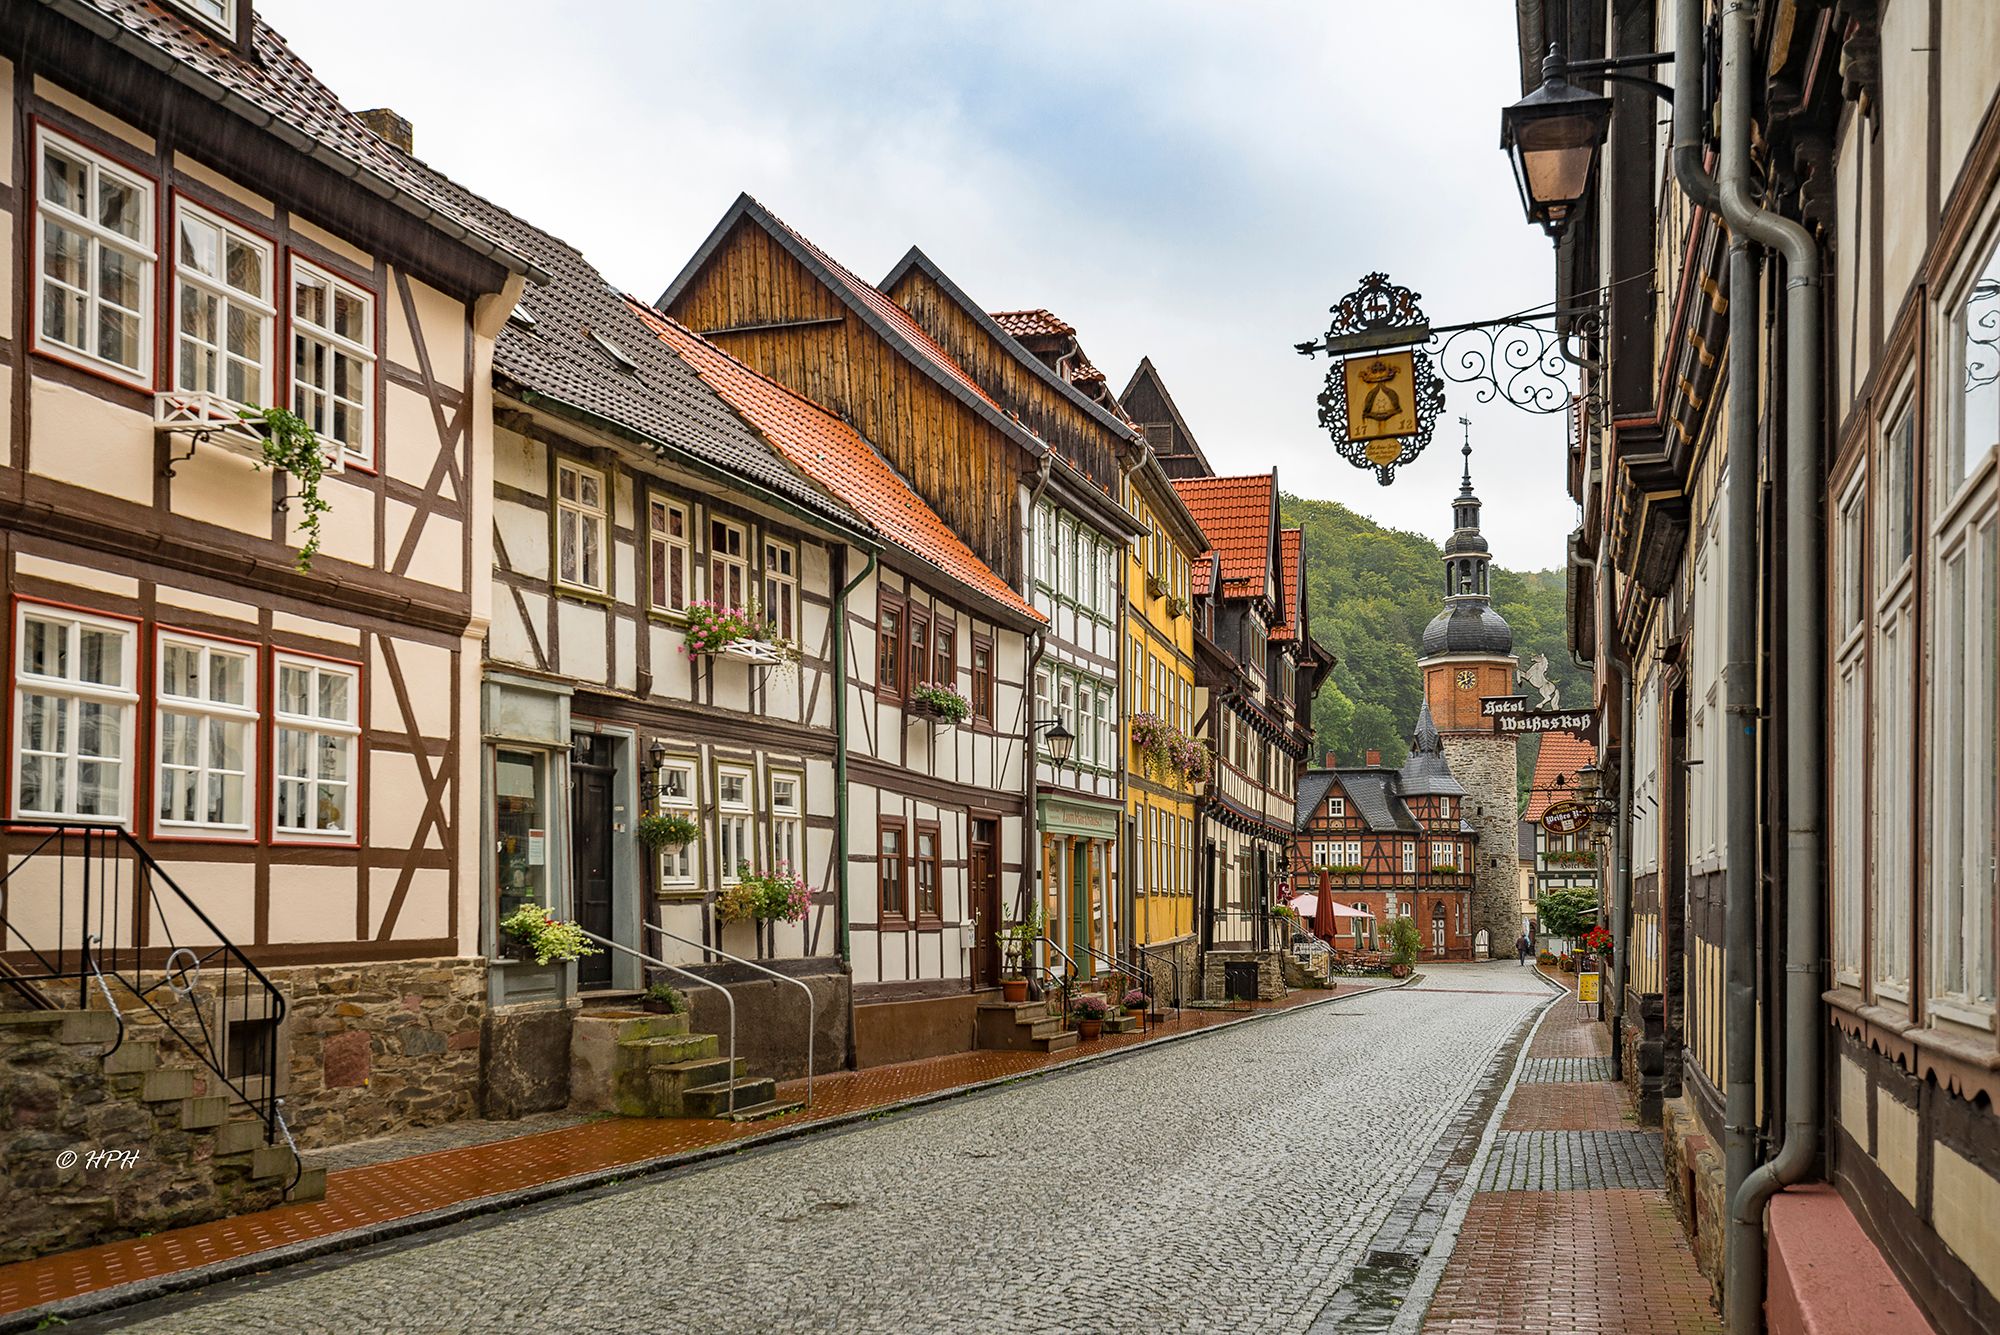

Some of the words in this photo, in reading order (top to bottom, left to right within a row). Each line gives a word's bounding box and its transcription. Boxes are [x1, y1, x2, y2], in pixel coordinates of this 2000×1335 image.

[1354, 425, 1368, 436] 17
[1398, 419, 1413, 430] 12
[1483, 700, 1525, 715] Hotel
[1499, 715, 1560, 732] Weißes
[1559, 714, 1592, 731] Roß
